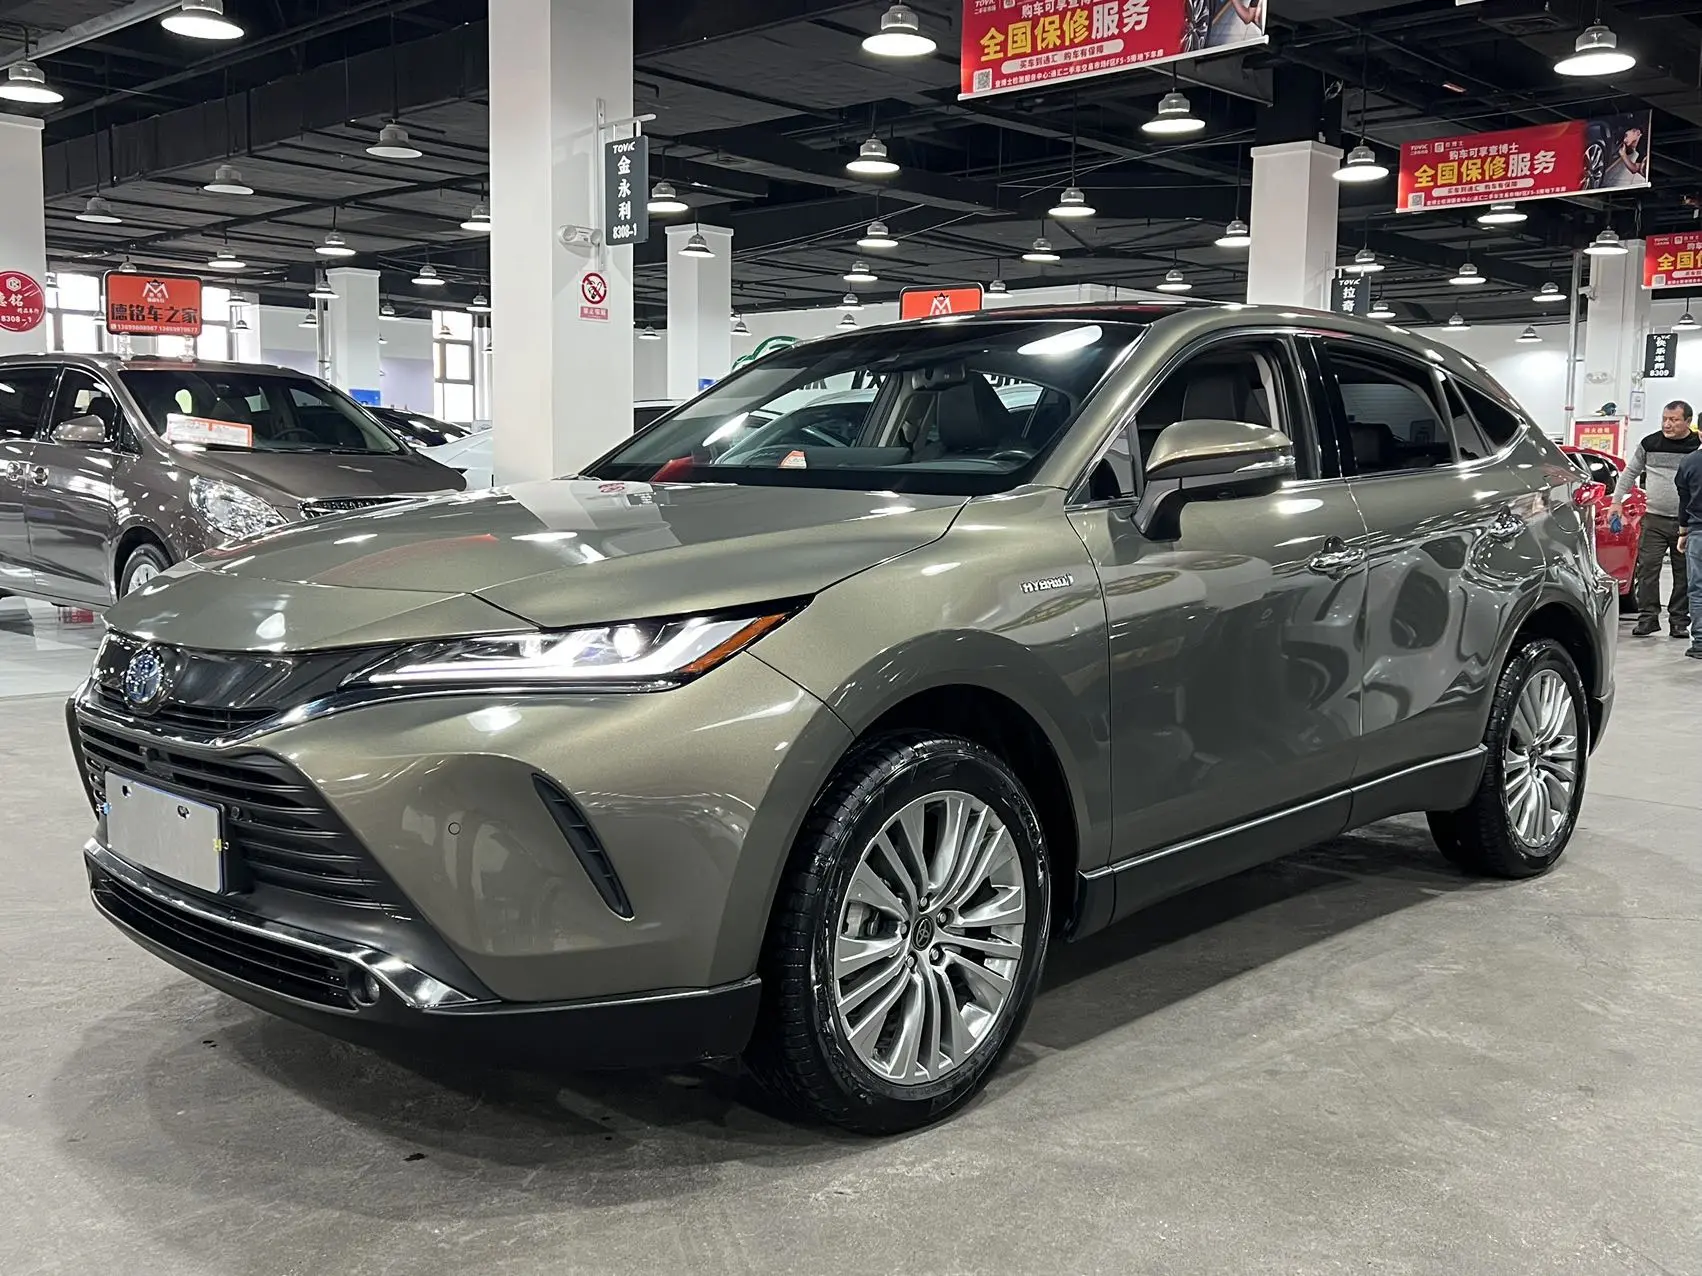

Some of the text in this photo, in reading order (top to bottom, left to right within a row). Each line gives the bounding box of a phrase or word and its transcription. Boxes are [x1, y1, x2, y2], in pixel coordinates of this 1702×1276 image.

[1021, 0, 1101, 18] 购车可享查
[979, 0, 1150, 61] 全国保修服务
[1064, 45, 1104, 60] 购车有保障
[613, 142, 635, 154] TOVIC
[1450, 142, 1519, 160] 购车可享查博士
[1414, 150, 1556, 188] 全国保修服务
[617, 155, 632, 220] 金永利
[1342, 286, 1356, 316] 拉奇
[111, 304, 198, 324] 德铭车之家
[1021, 575, 1072, 593] HYBRID
